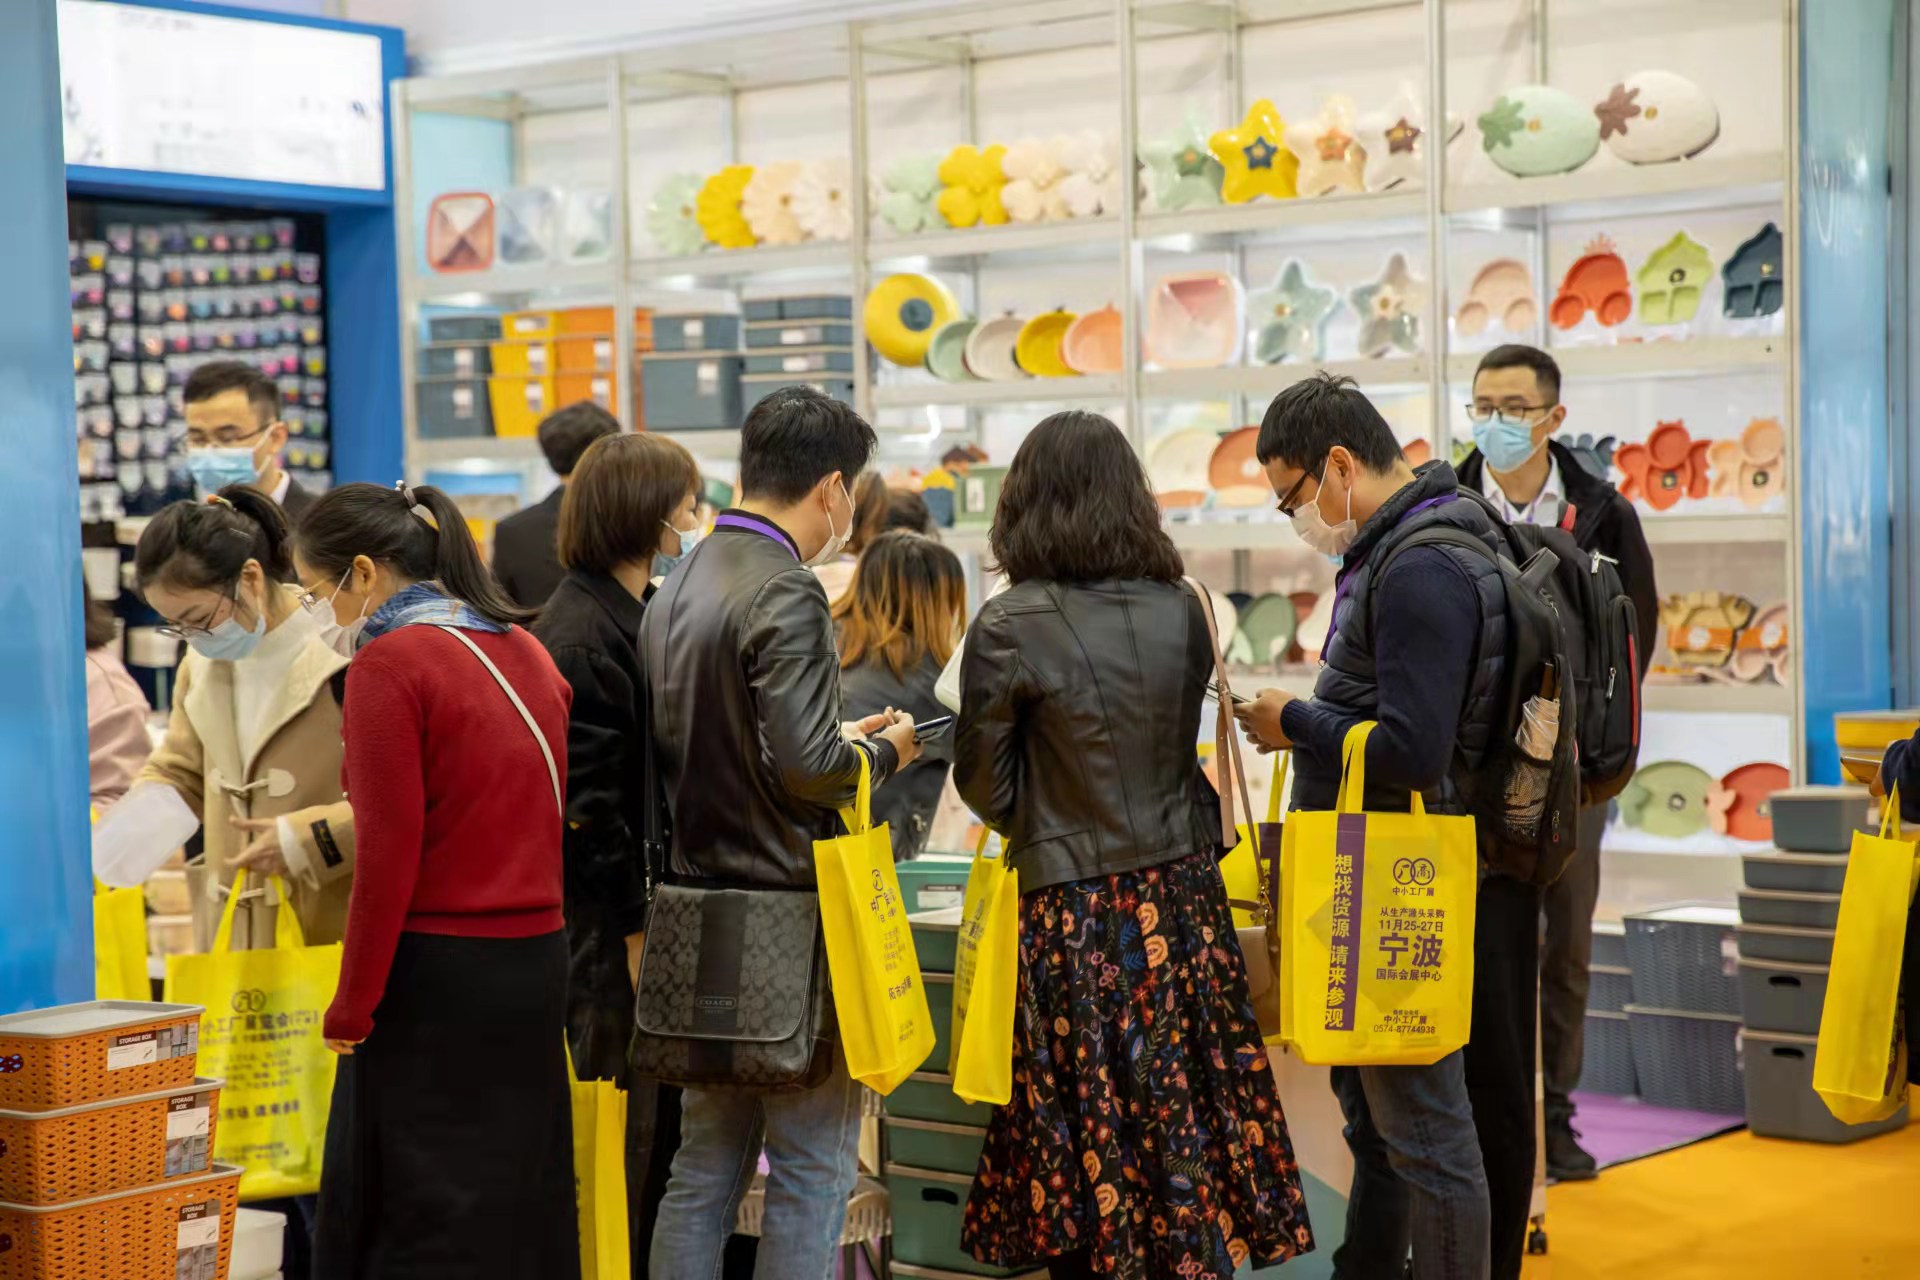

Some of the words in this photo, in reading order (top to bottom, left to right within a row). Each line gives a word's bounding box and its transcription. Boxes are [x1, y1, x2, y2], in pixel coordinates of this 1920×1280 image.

[1331, 854, 1353, 938] 想找货源
[1392, 886, 1434, 897] 中小工厂展
[1379, 907, 1445, 919] 从生产源头采购
[1379, 919, 1444, 932] 11月25-27日
[1379, 932, 1443, 968] 宁波
[1376, 968, 1442, 982] 国际会展中心
[1325, 944, 1349, 1028] 请来参观
[1384, 1015, 1428, 1025] 中小工厂展
[1373, 1024, 1436, 1034] 0574-87744938
[119, 1035, 141, 1045] STORAGE
[142, 1033, 152, 1041] BOX
[171, 1095, 194, 1105] STORAGE
[175, 1103, 188, 1111] BOX
[182, 1204, 205, 1214] STORAGE
[187, 1211, 198, 1220] BOX
